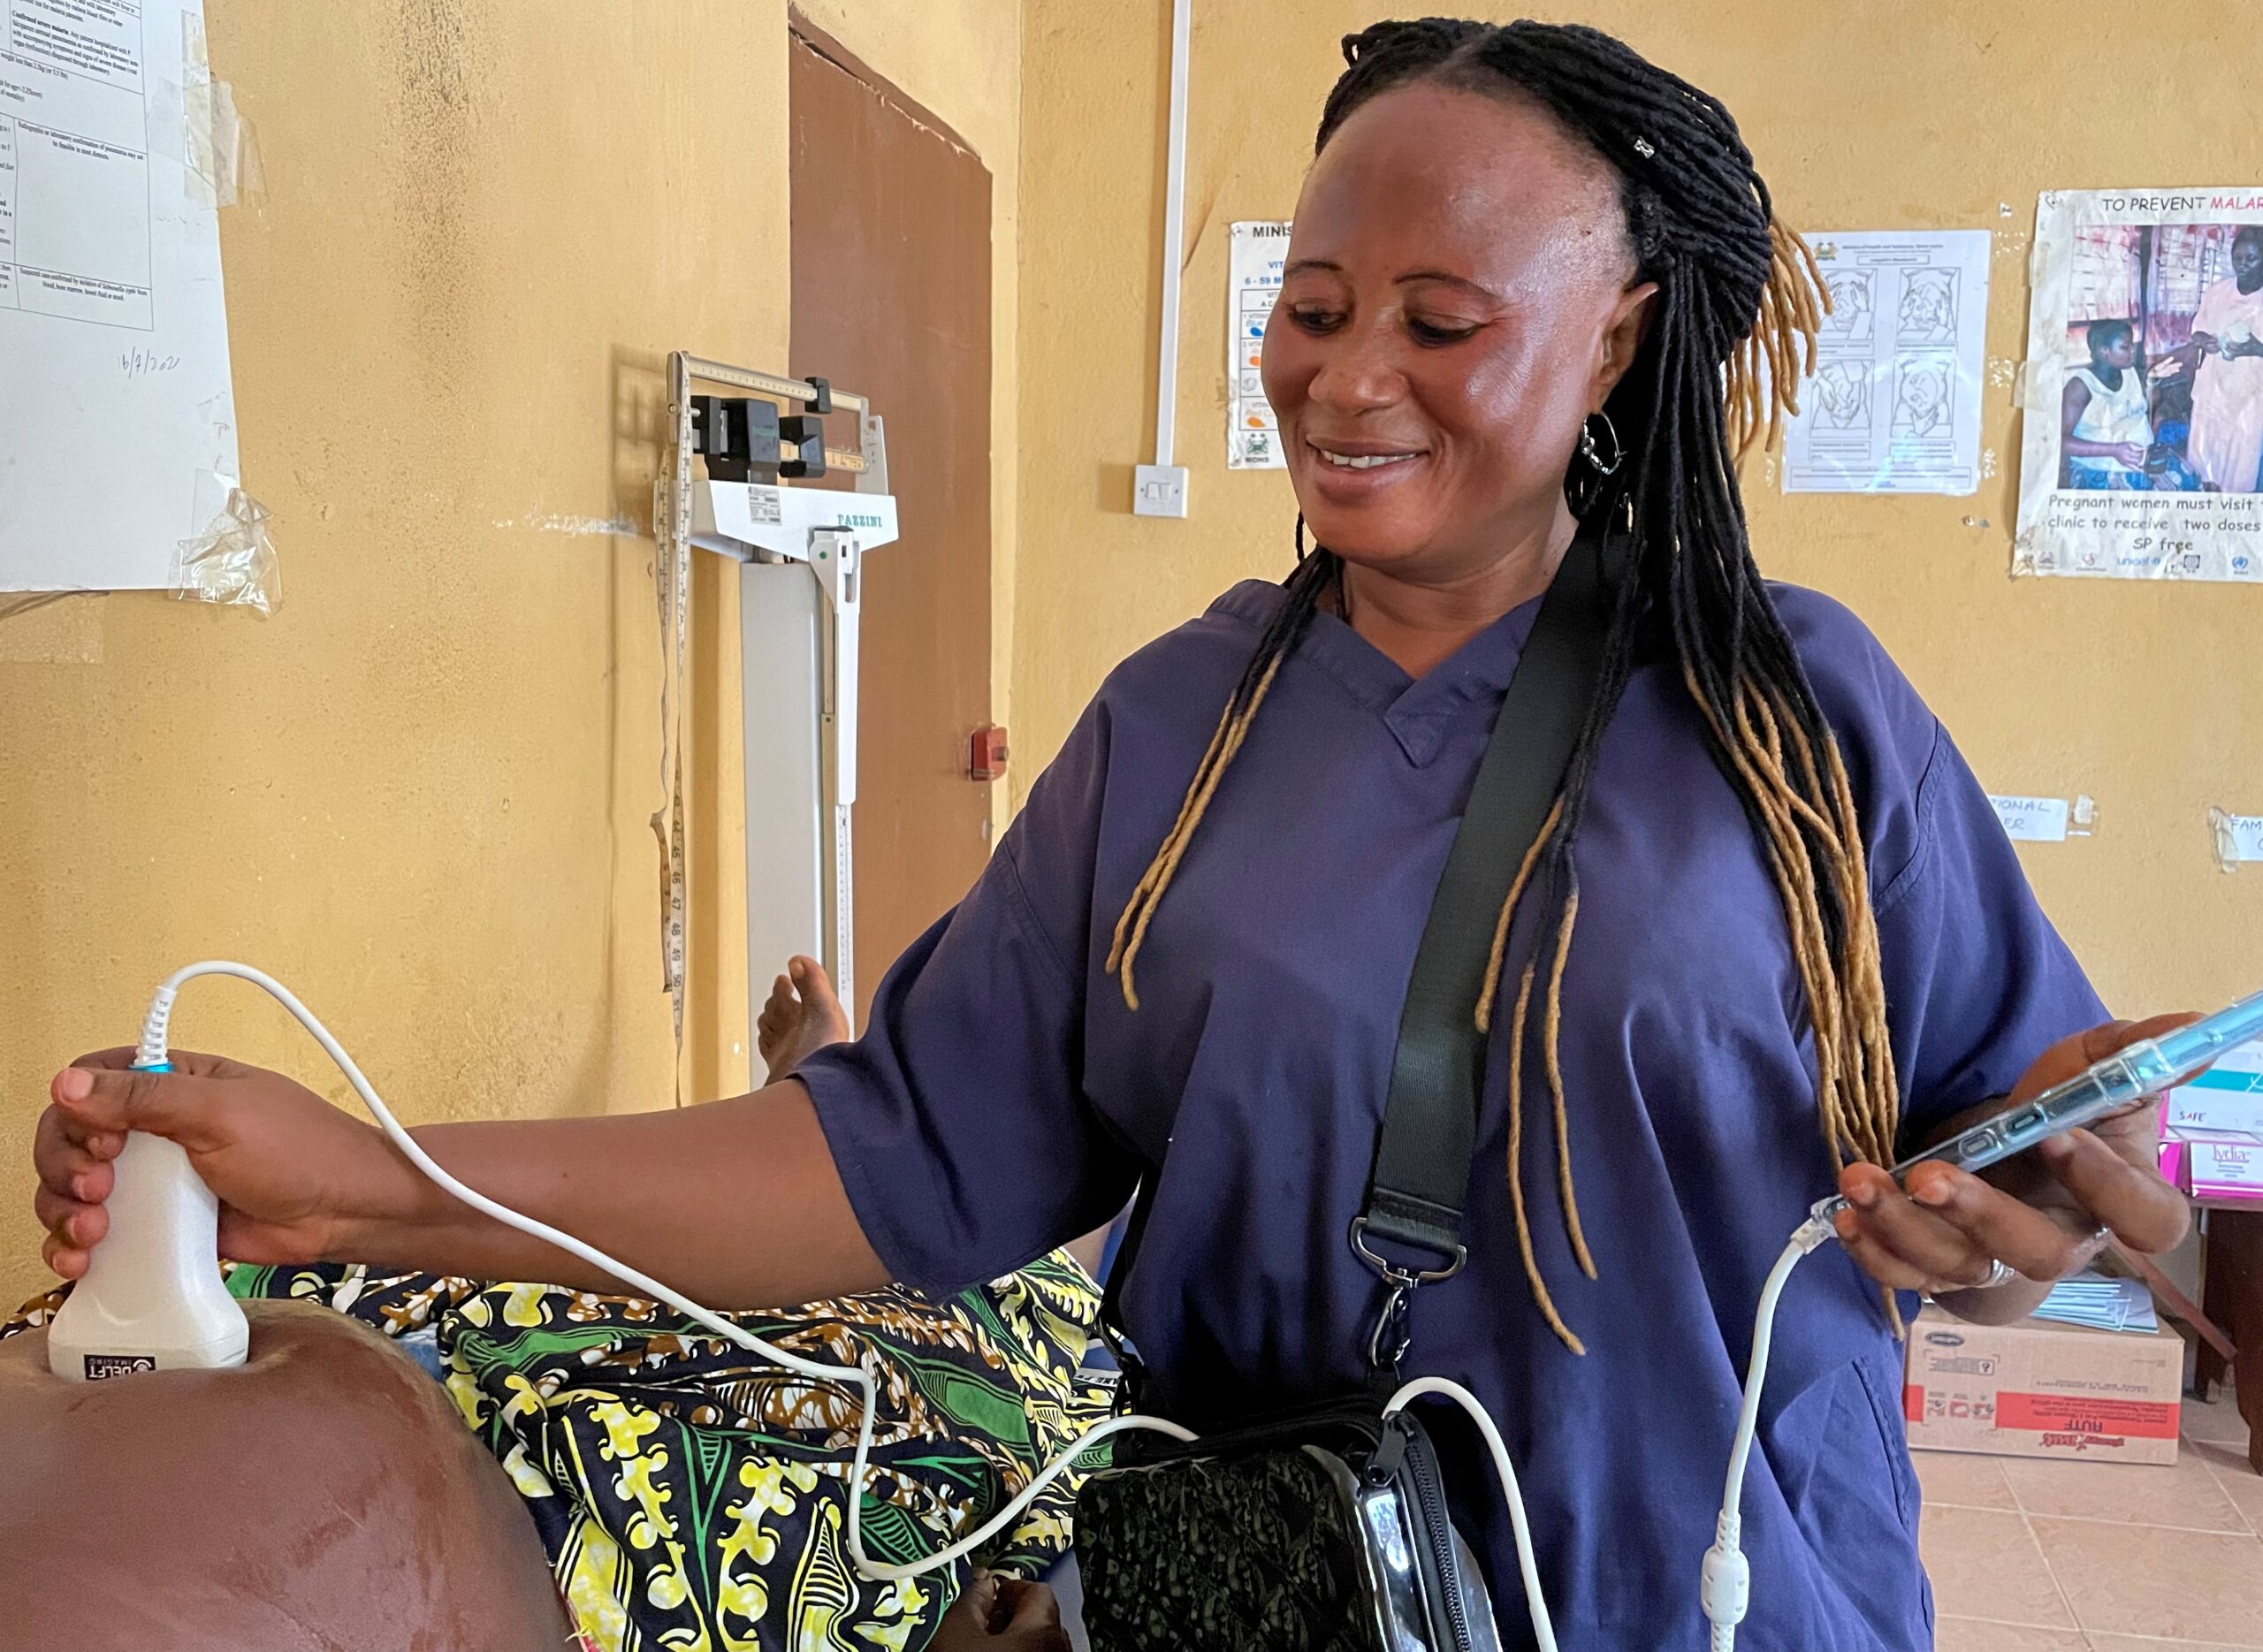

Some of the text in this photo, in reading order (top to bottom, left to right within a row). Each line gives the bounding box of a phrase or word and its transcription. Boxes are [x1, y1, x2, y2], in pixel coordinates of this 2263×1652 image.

[2102, 196, 2263, 211] TO PREVENT MALAR
[1253, 225, 1292, 238] MINIS
[2048, 494, 2114, 511] Pregnant
[2122, 498, 2170, 509] women
[2176, 497, 2213, 510] must
[2220, 497, 2254, 510] visit
[2047, 515, 2261, 531] clinic to receive two doses
[2133, 537, 2193, 551] SP free
[1991, 798, 2051, 812] TIONAL
[673, 819, 681, 833] 44
[2231, 818, 2262, 832] FAM
[672, 846, 681, 858] 45
[672, 871, 681, 885] 46
[672, 896, 682, 910] 47
[672, 923, 681, 936] 48
[672, 948, 681, 962] 49
[673, 974, 682, 987] 50
[673, 1000, 680, 1011] 51
[2179, 1111, 2204, 1122] SAFE
[2213, 1145, 2246, 1162] lydia
[89, 1365, 132, 1378] DELFT
[2063, 1420, 2103, 1432] RUTF
